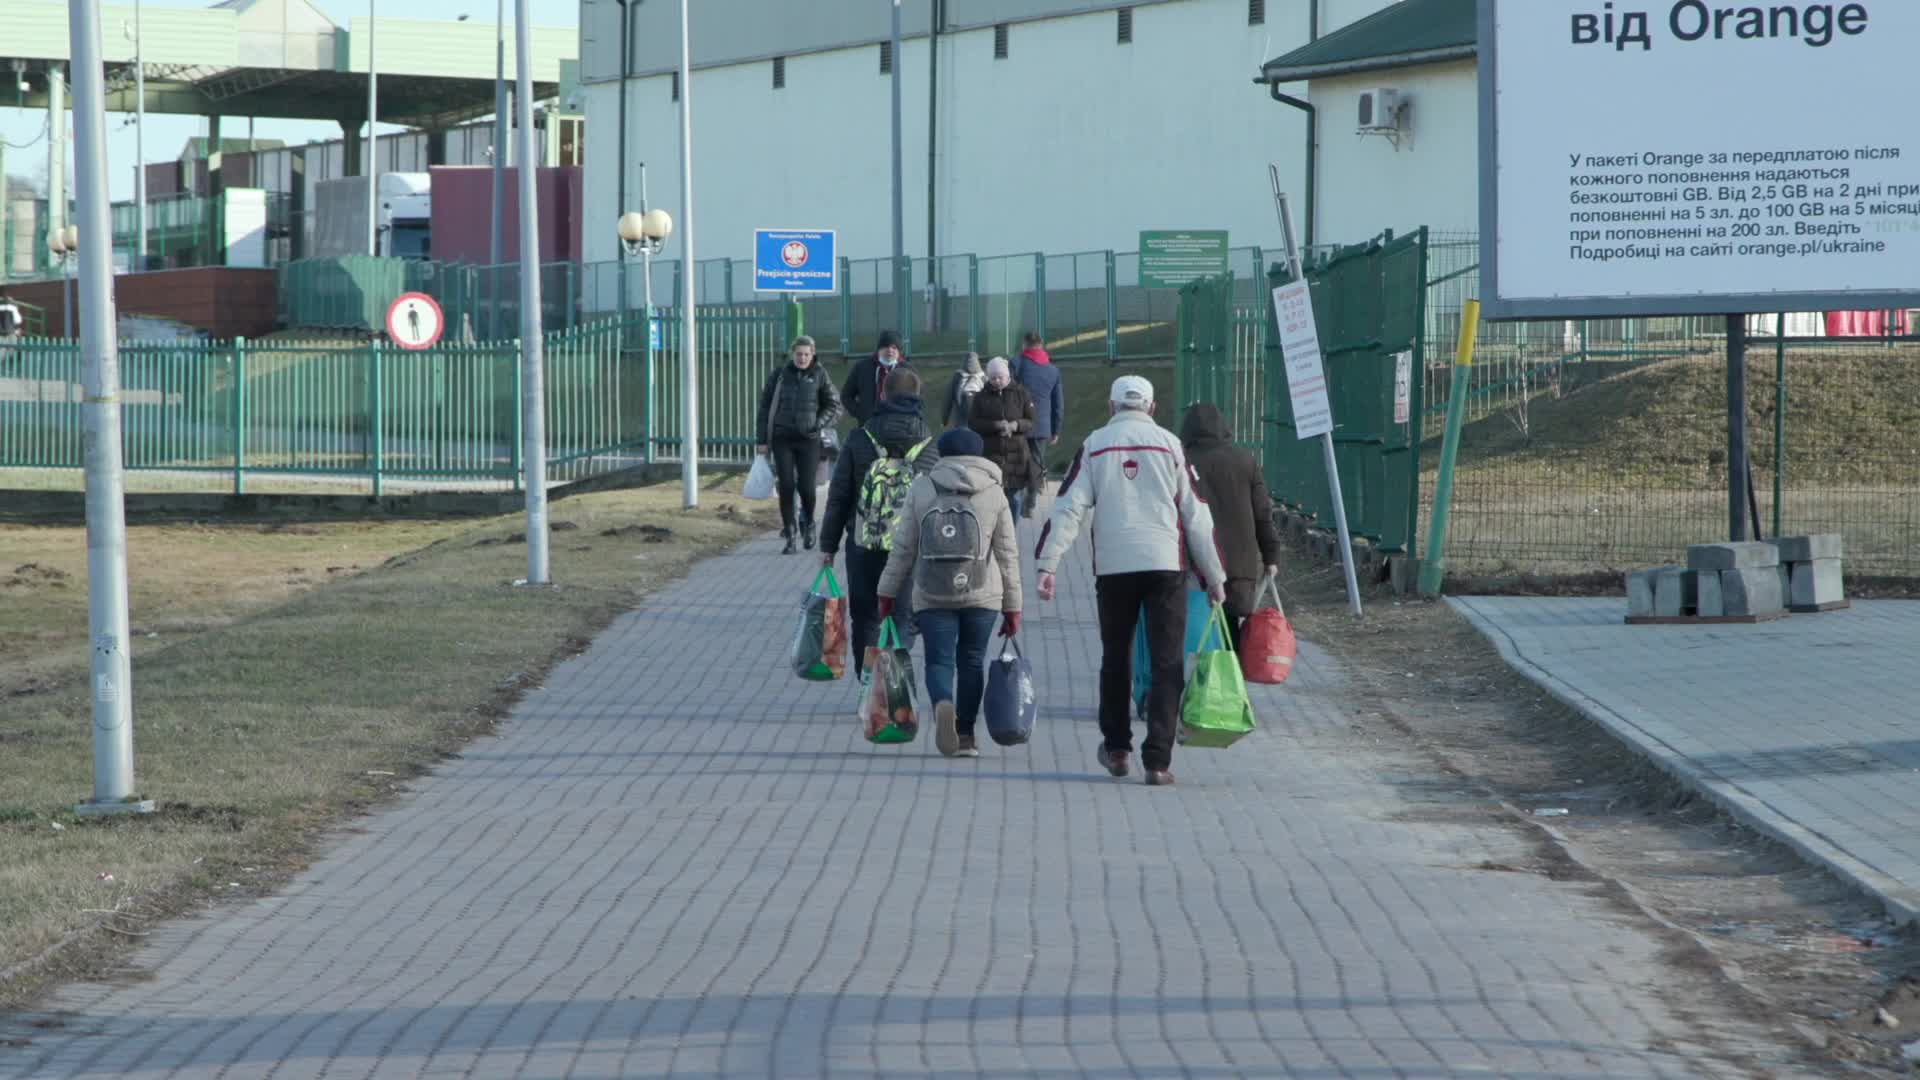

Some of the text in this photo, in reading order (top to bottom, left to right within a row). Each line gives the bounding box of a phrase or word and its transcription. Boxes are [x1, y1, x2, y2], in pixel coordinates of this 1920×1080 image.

[1571, 0, 1868, 51] від Orange
[1570, 146, 1900, 168] У пакеті Orange за передплатою після
[1570, 168, 1850, 186] кожного поповнення надаються
[1570, 182, 1920, 204] безкоштовні GB. Від 2,5 GB на 2 дні при
[1570, 207, 1666, 223] поповненні
[1671, 208, 1690, 220] на
[1695, 206, 1705, 219] 5
[1709, 208, 1733, 219] зл.
[1738, 207, 1760, 221] до
[1766, 204, 1794, 218] 100
[1799, 202, 1824, 217] GB
[1829, 204, 1850, 216] на
[1855, 202, 1865, 215] 5
[1569, 229, 1601, 243] при
[1605, 225, 1701, 240] поповненні
[1706, 226, 1726, 238] на
[1731, 223, 1760, 237] 200
[1765, 225, 1789, 236] зл.
[1795, 221, 1861, 236] Введіть
[1570, 238, 1886, 261] Подробиці на сайті orange.pl/ukraine
